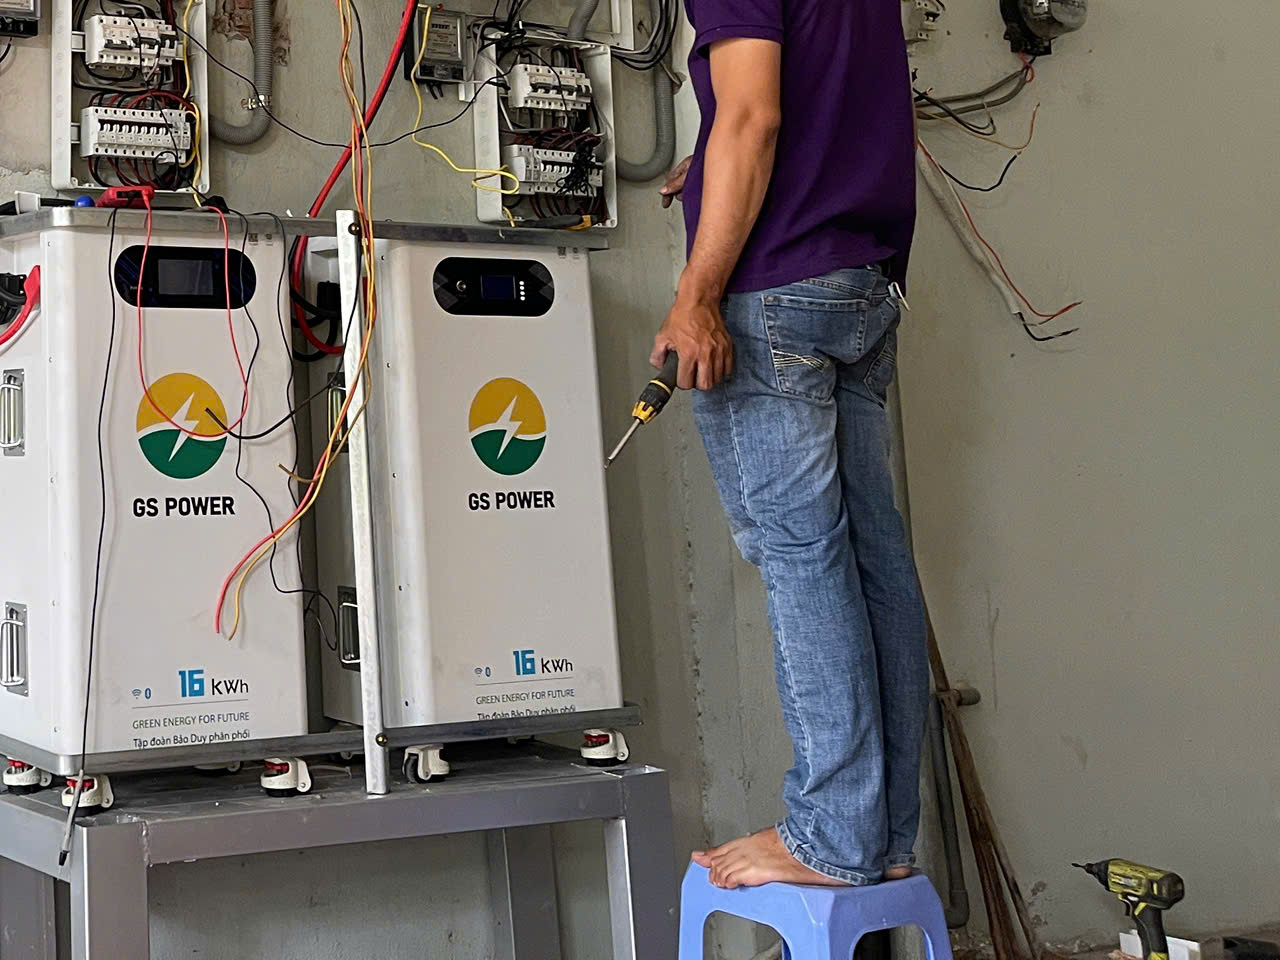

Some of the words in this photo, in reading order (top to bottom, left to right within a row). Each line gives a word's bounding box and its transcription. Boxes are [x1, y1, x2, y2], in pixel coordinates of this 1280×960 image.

[133, 497, 159, 517] GS
[165, 496, 235, 517] POWER
[468, 493, 490, 510] GS
[495, 491, 555, 509] POWER
[512, 649, 536, 676] 16
[541, 658, 573, 674] kWh
[178, 669, 205, 698] 16
[211, 678, 249, 695] kWh
[476, 695, 500, 705] GREEN
[502, 692, 530, 703] ENERGY
[532, 691, 545, 700] FOR
[548, 688, 575, 698] FUTURE
[132, 719, 161, 729] GREEN
[163, 716, 196, 727] ENERGY
[198, 714, 216, 724] FOR
[217, 711, 250, 722] FUTURE
[190, 733, 207, 745] Duy
